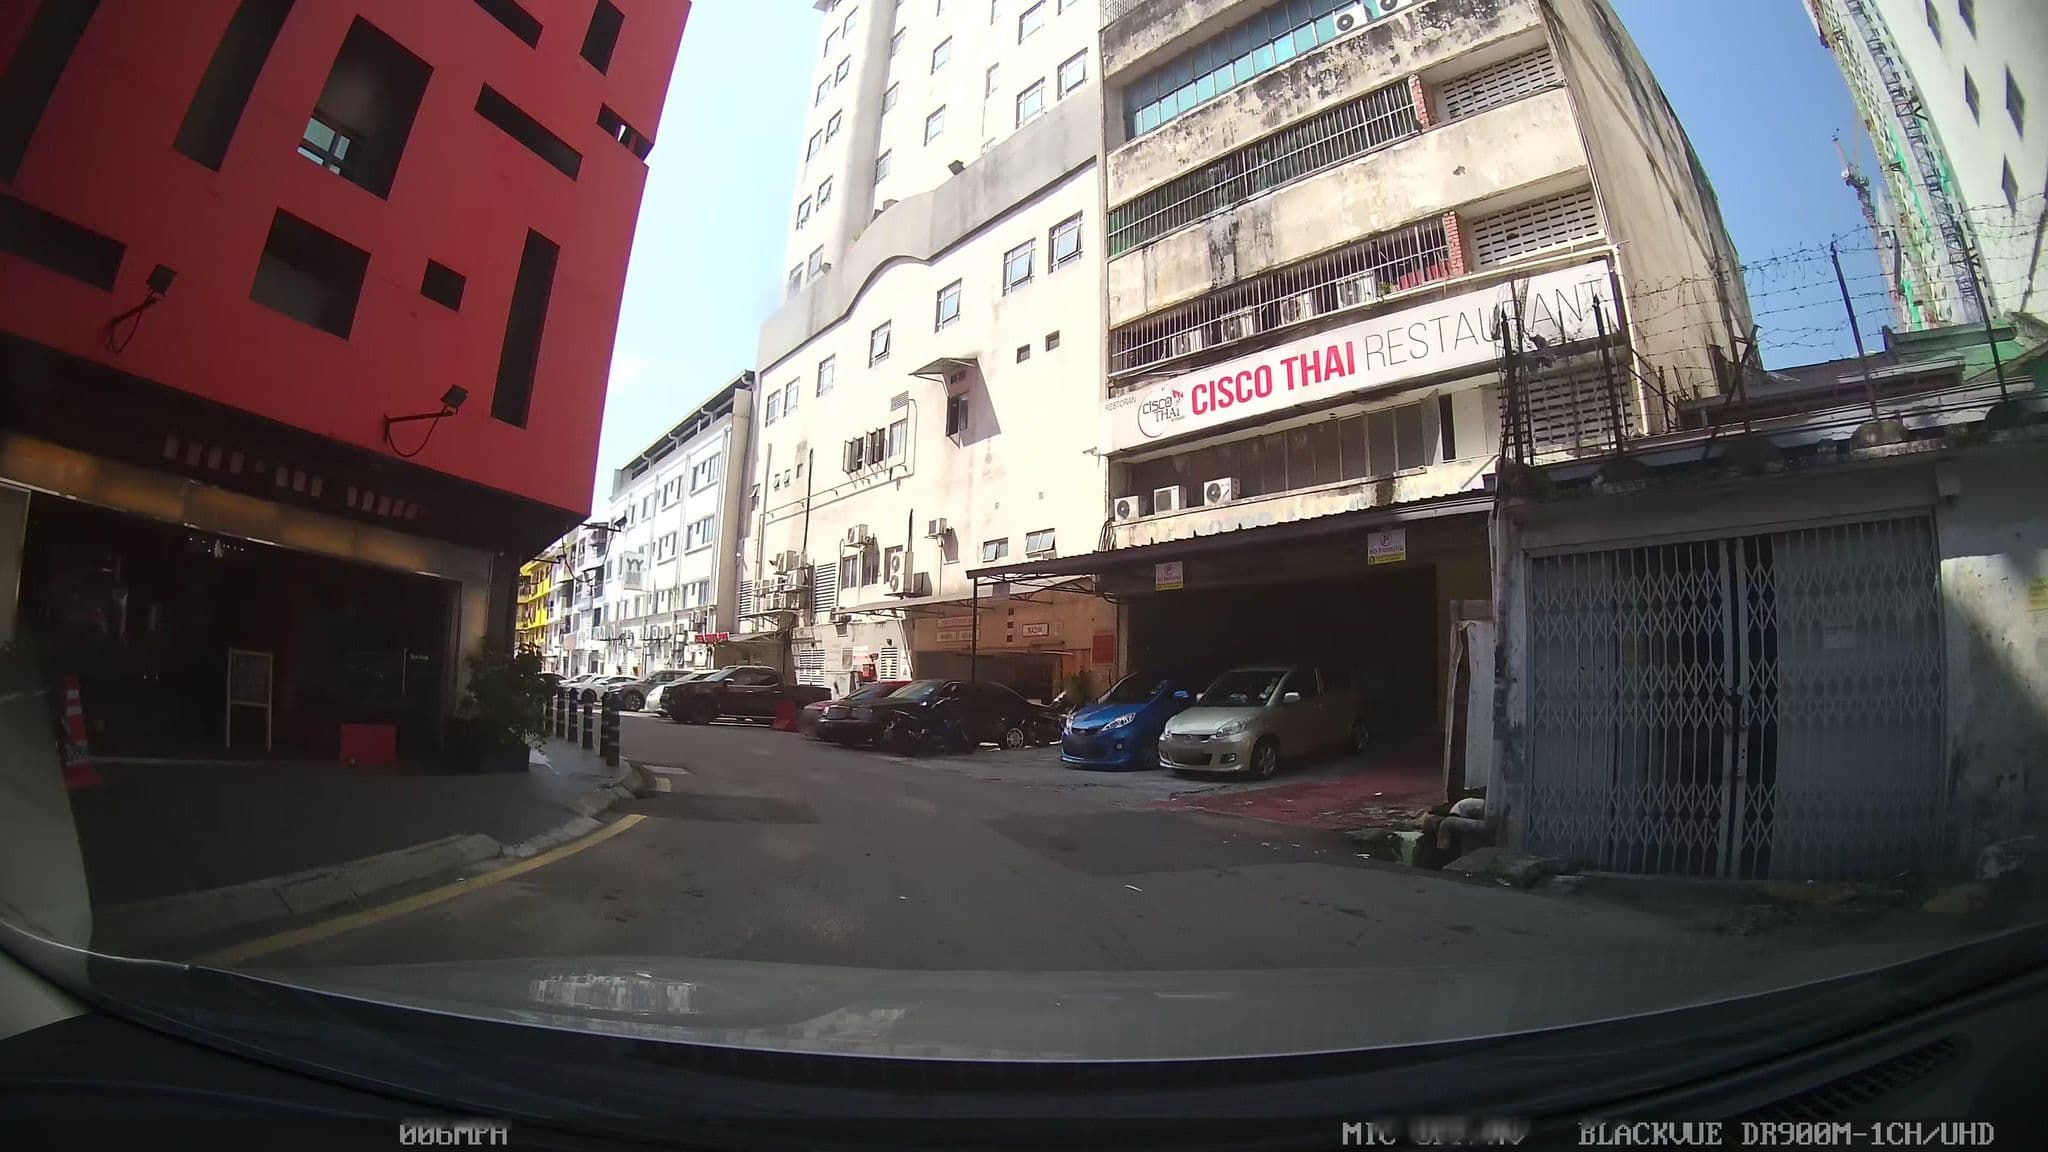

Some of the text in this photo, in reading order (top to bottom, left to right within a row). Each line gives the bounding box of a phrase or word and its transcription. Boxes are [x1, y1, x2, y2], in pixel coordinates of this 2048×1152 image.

[1190, 278, 1602, 416] CISCO THAI RESTAURANT
[1105, 395, 1137, 412] RESTORAN
[1142, 396, 1173, 415] CISCO
[1154, 407, 1180, 423] THAI
